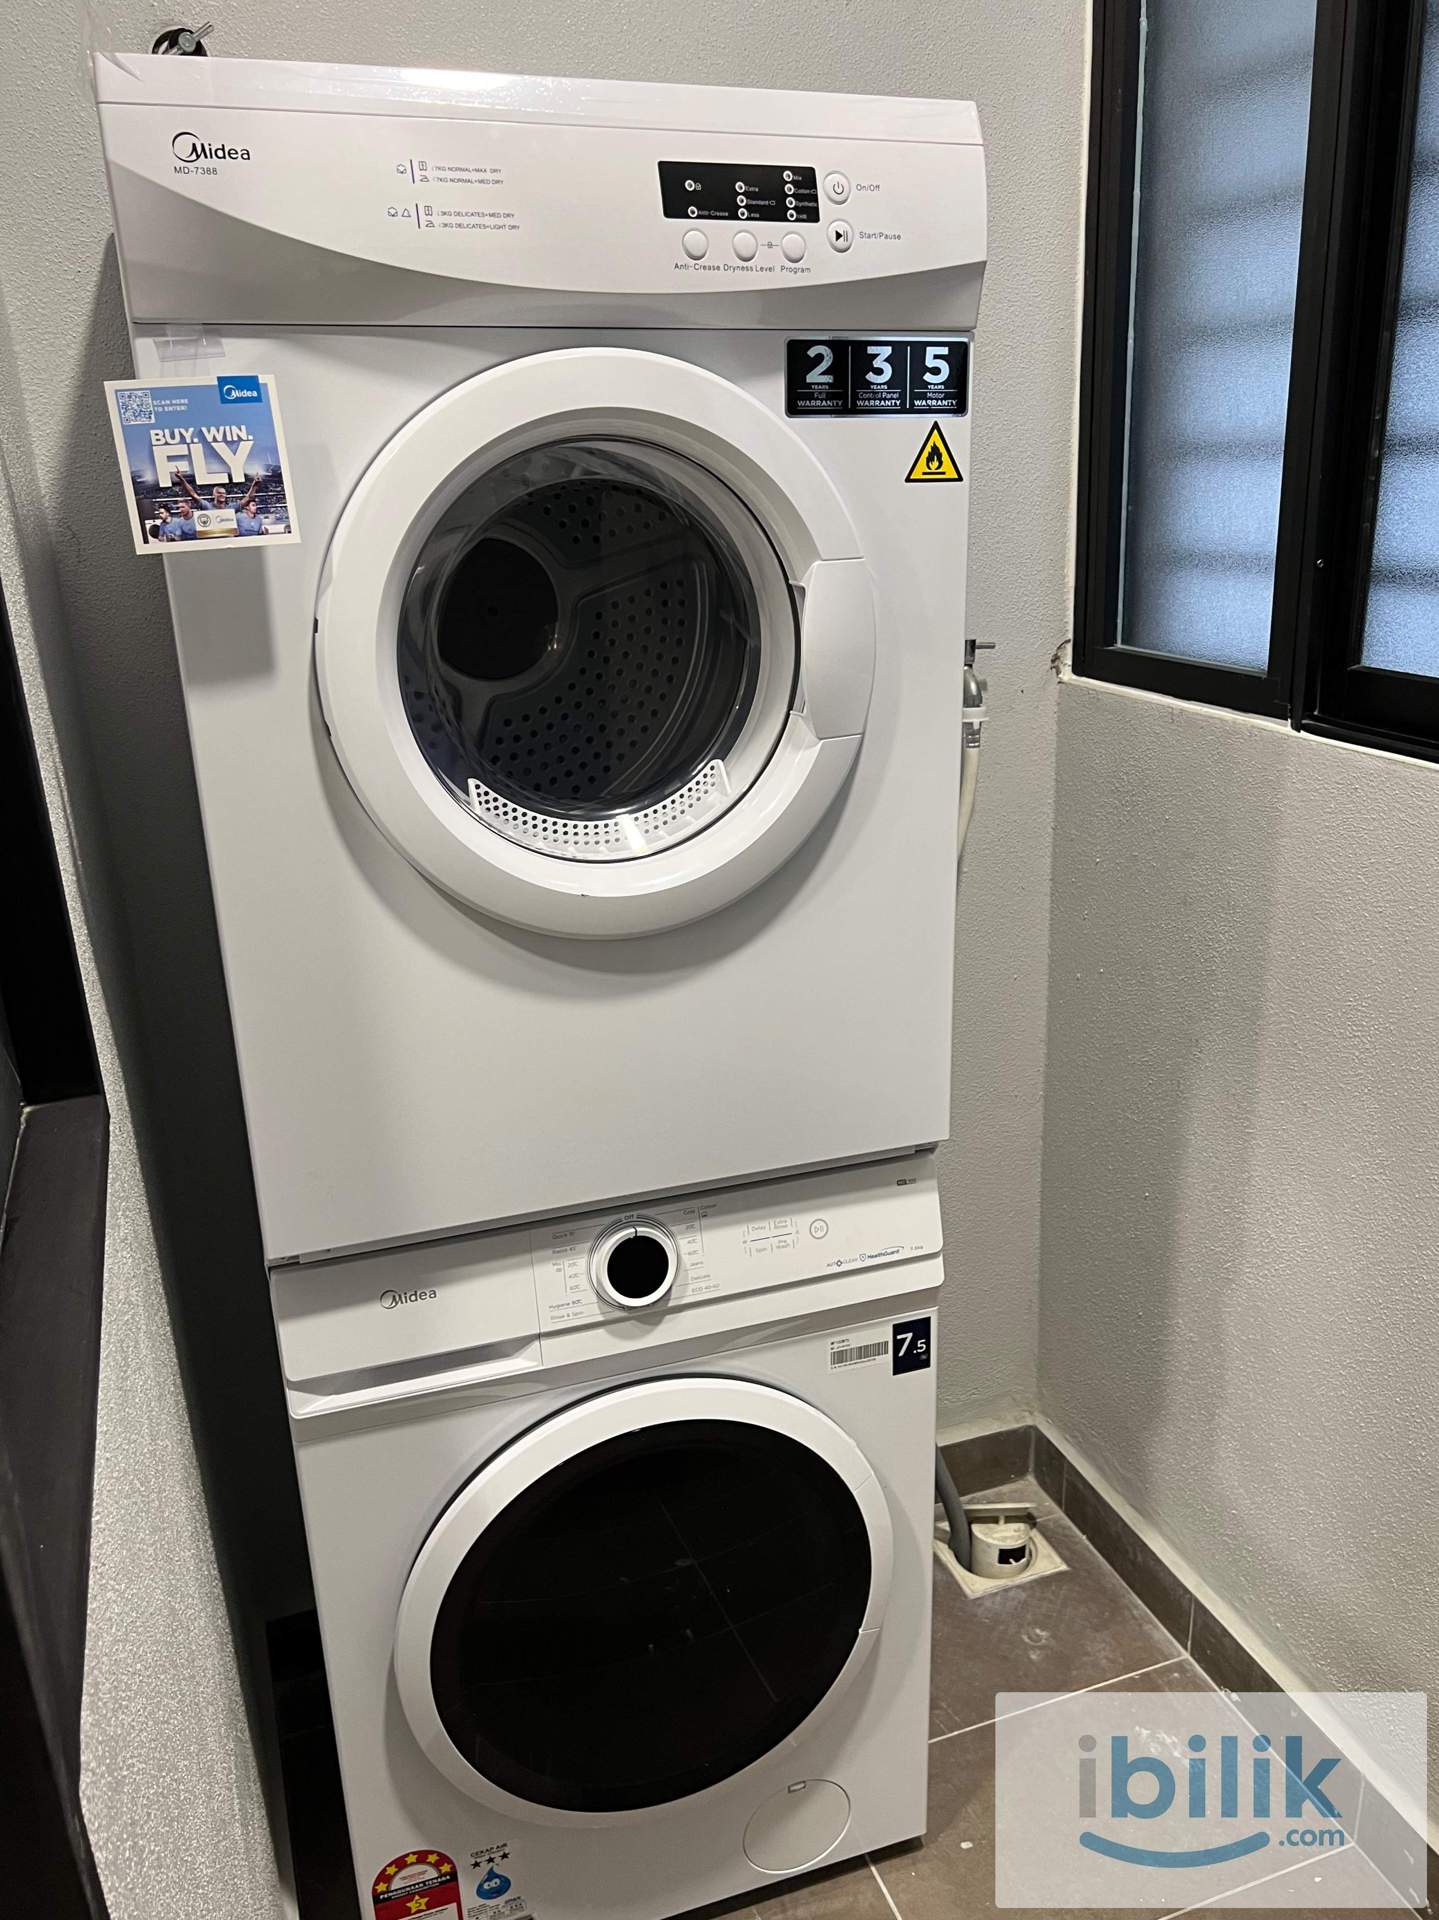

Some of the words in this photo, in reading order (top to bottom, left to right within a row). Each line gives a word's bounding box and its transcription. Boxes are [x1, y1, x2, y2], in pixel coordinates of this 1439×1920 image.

[171, 131, 251, 163] Midea
[173, 166, 218, 176] MD-7388
[855, 183, 881, 192] On/Off
[858, 231, 902, 241] Start/Pause
[673, 262, 721, 272] Anti-Crease
[722, 264, 753, 274] Dryness
[755, 265, 776, 273] Level
[780, 265, 812, 275] Program
[805, 345, 834, 383] 2
[865, 346, 893, 384] 3
[922, 346, 950, 384] 5
[223, 384, 258, 400] Midea
[150, 427, 199, 446] BUY.
[202, 425, 254, 442] WIN.
[152, 440, 254, 488] FLY
[379, 1288, 438, 1310] Midea
